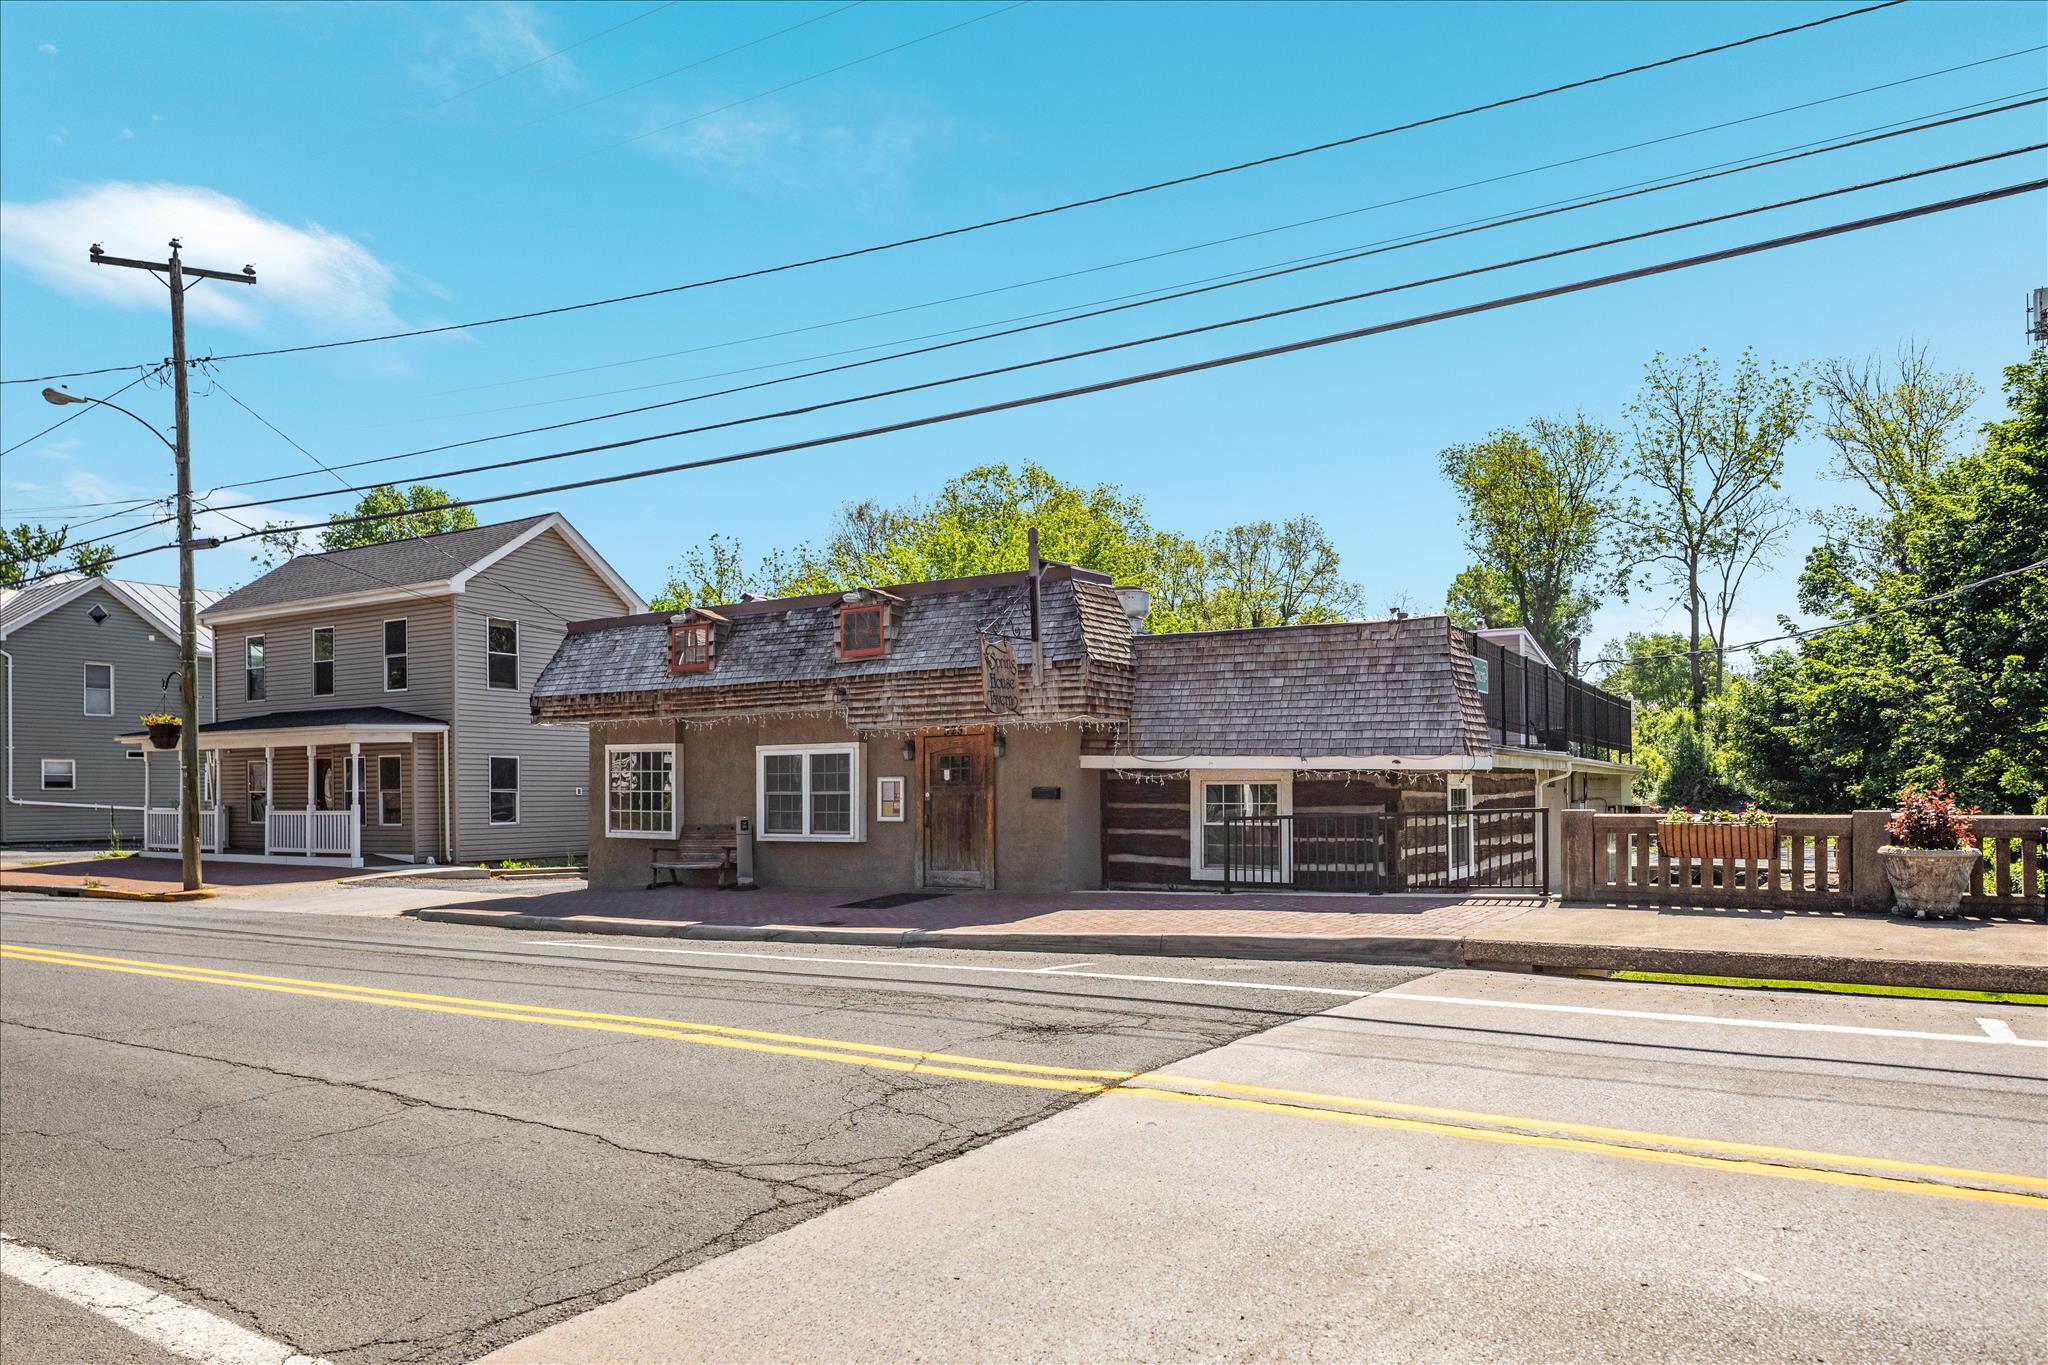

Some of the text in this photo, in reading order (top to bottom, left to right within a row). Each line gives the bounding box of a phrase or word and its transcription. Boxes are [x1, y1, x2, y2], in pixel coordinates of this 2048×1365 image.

[985, 653, 1017, 675] Spring
[989, 673, 1016, 689] House
[988, 691, 1017, 708] Tavern
